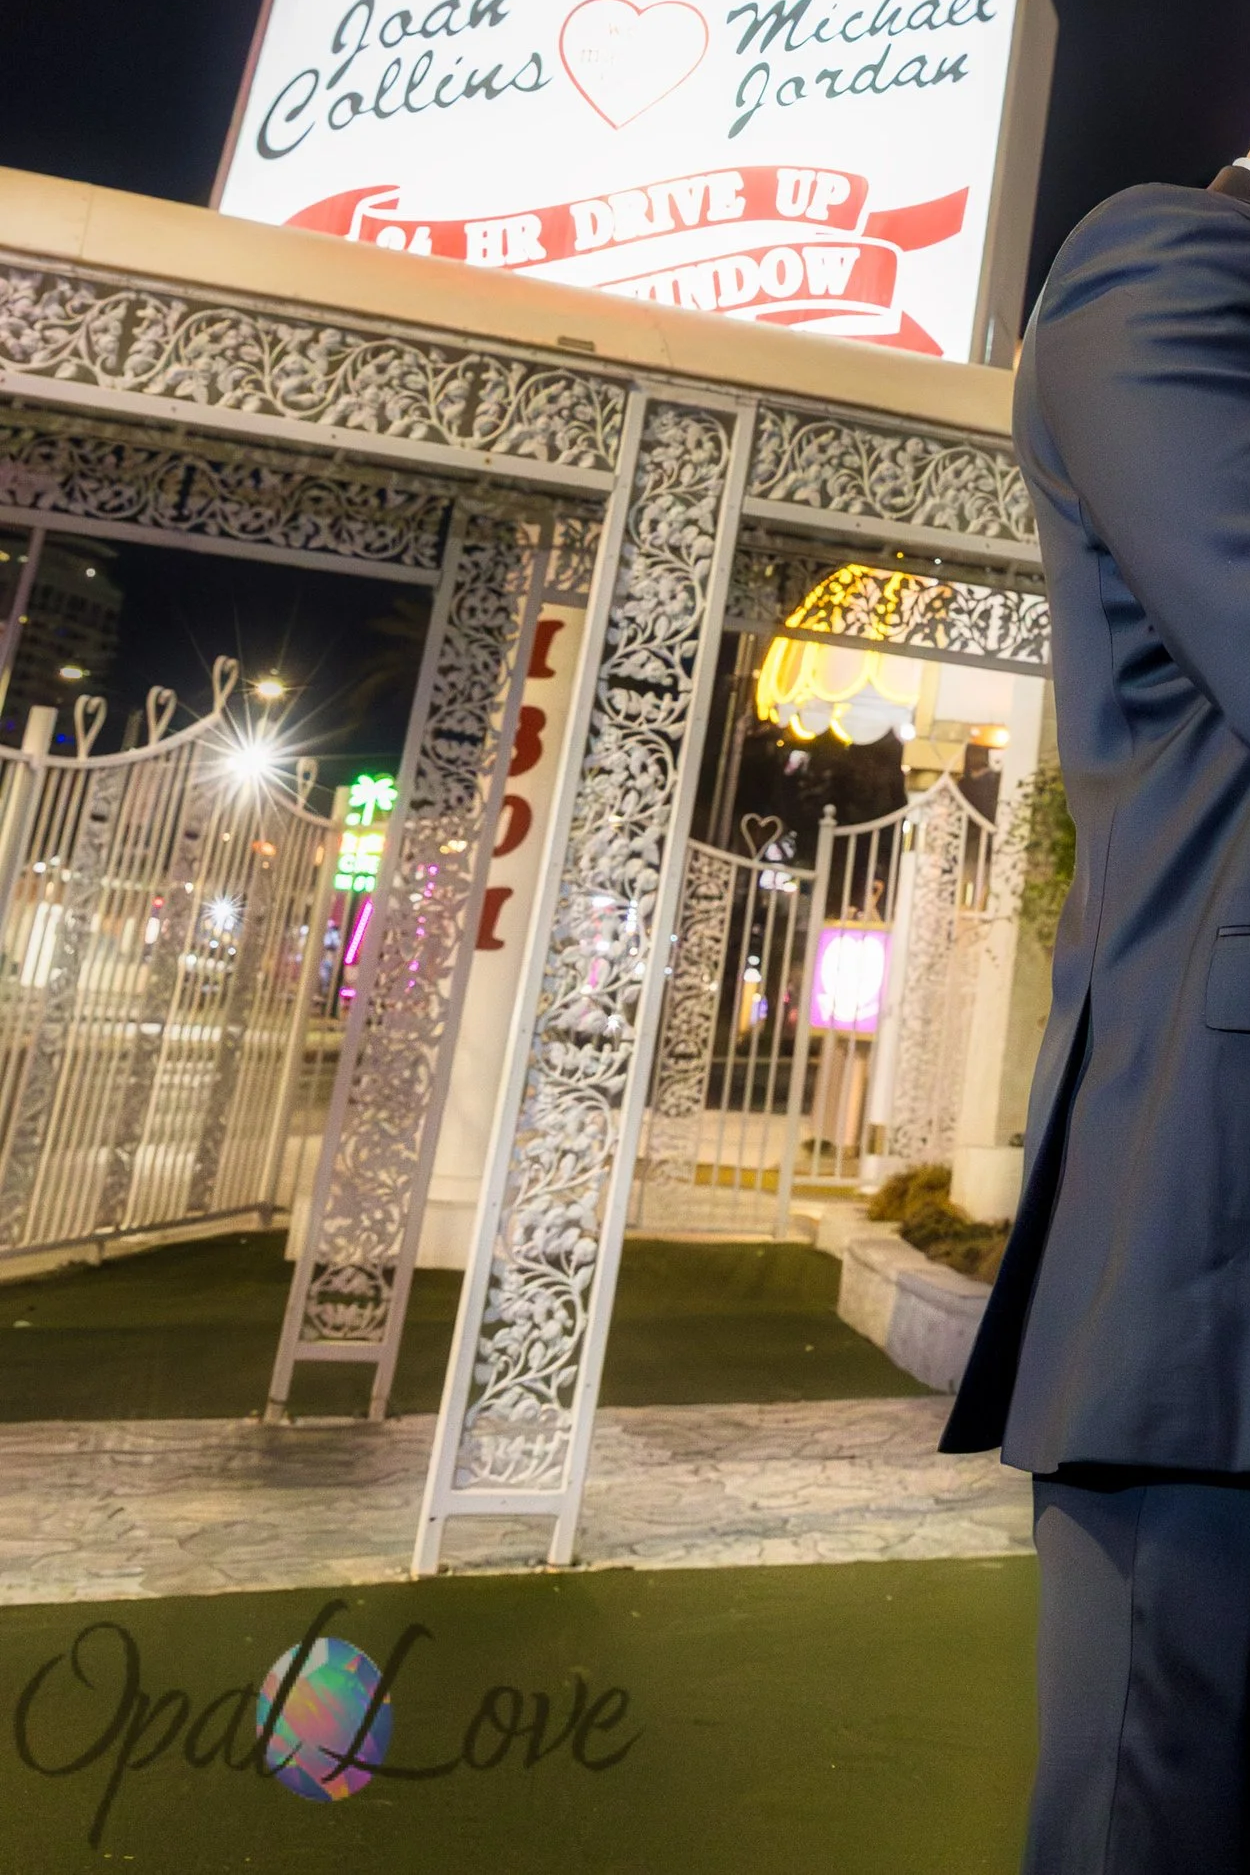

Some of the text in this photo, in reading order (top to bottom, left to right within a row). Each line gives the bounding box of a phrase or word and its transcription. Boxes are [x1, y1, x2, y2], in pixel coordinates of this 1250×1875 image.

[257, 50, 553, 159] Collins
[727, 43, 969, 139] Jordan
[464, 214, 547, 267] HR
[569, 171, 747, 251] DRIVE
[775, 168, 850, 220] UP
